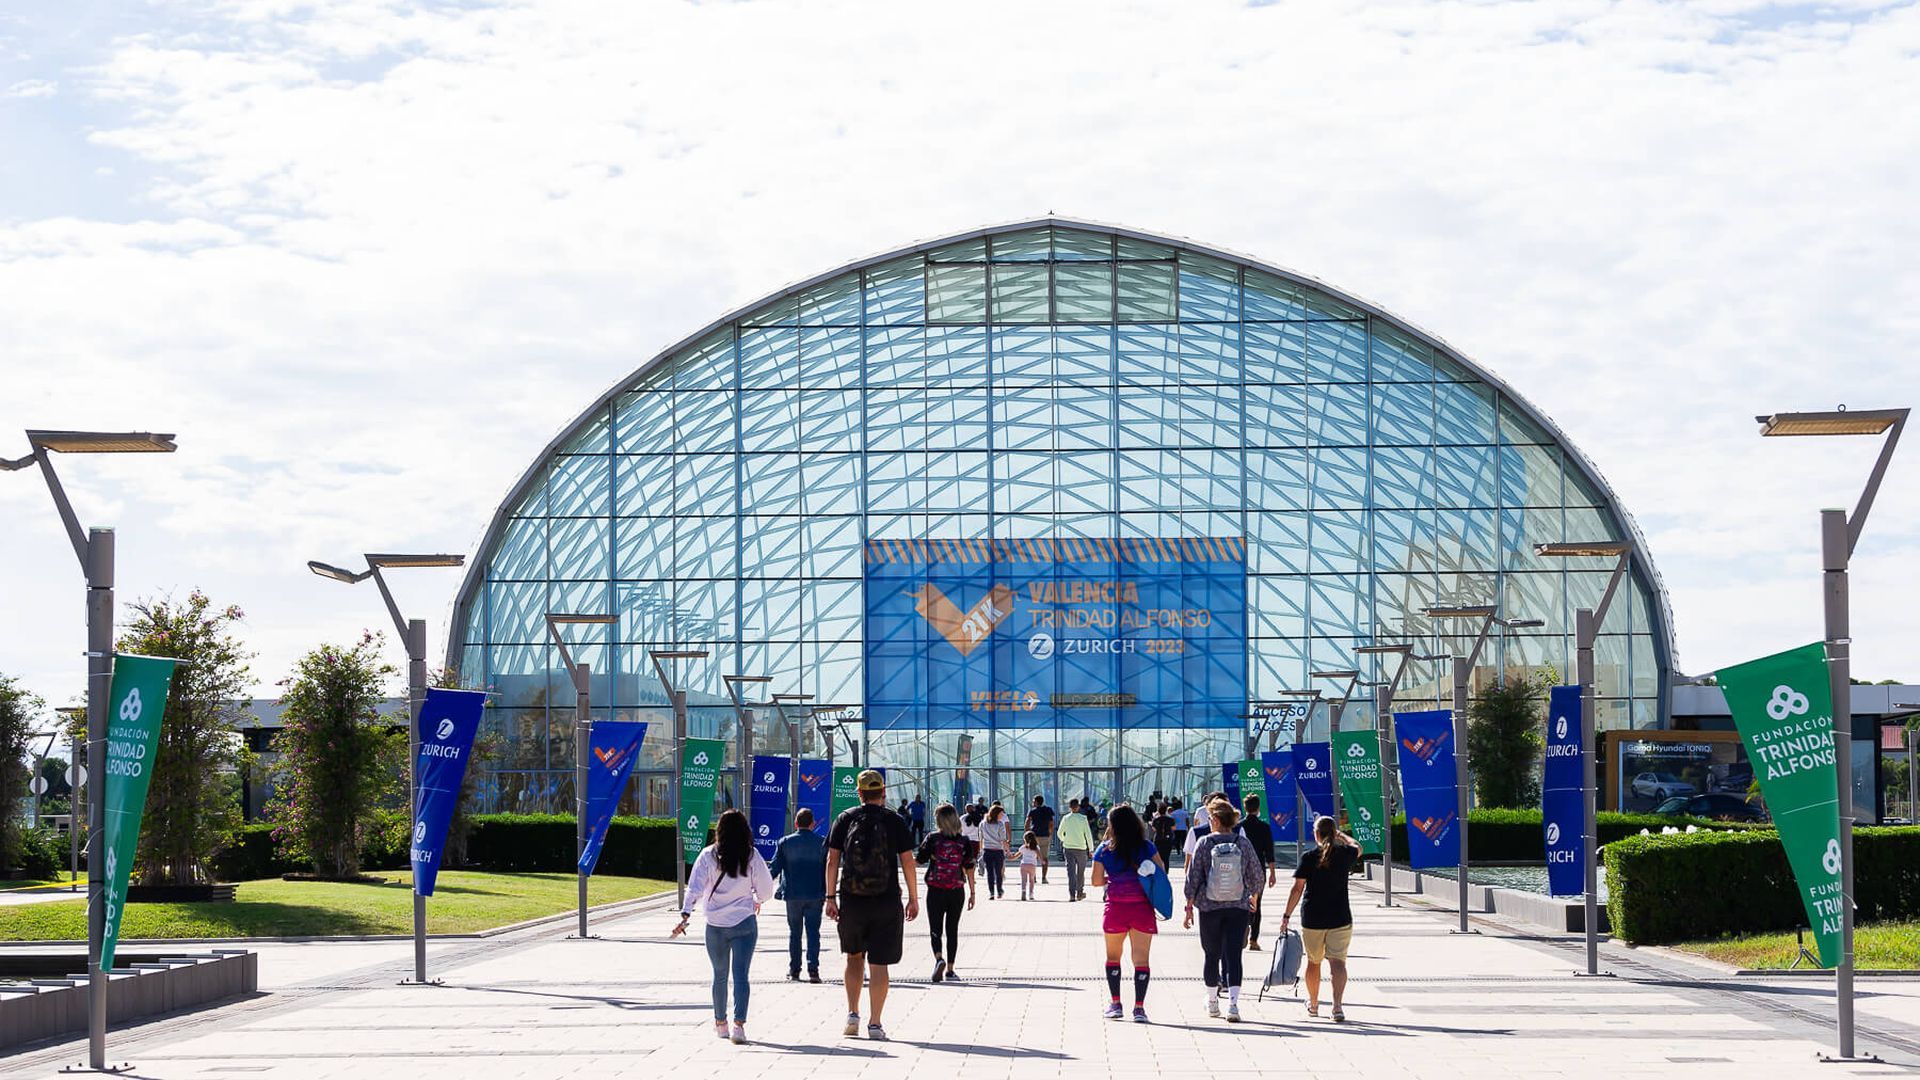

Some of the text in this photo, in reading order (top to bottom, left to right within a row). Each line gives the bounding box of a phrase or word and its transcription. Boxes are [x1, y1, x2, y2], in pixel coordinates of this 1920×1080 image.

[1027, 581, 1140, 604] VALENCIA
[961, 597, 1004, 645] 21K
[1027, 609, 1212, 629] TRINIDAD ALFONSO
[1063, 639, 1135, 654] ZURICH
[1145, 639, 1185, 654] 2023
[970, 690, 1038, 712] VUELO
[107, 741, 146, 760] RINIDAD
[421, 743, 460, 760] ZURICH
[1547, 743, 1578, 758] ZURICH
[1652, 743, 1687, 756] Hyundai
[106, 759, 142, 777] LFONSO
[1298, 771, 1327, 780] ZURICH
[683, 780, 713, 788] ALFONSO
[684, 772, 715, 781] TRINIDAD
[754, 785, 783, 794] ZURICH
[1549, 850, 1575, 863] RICH
